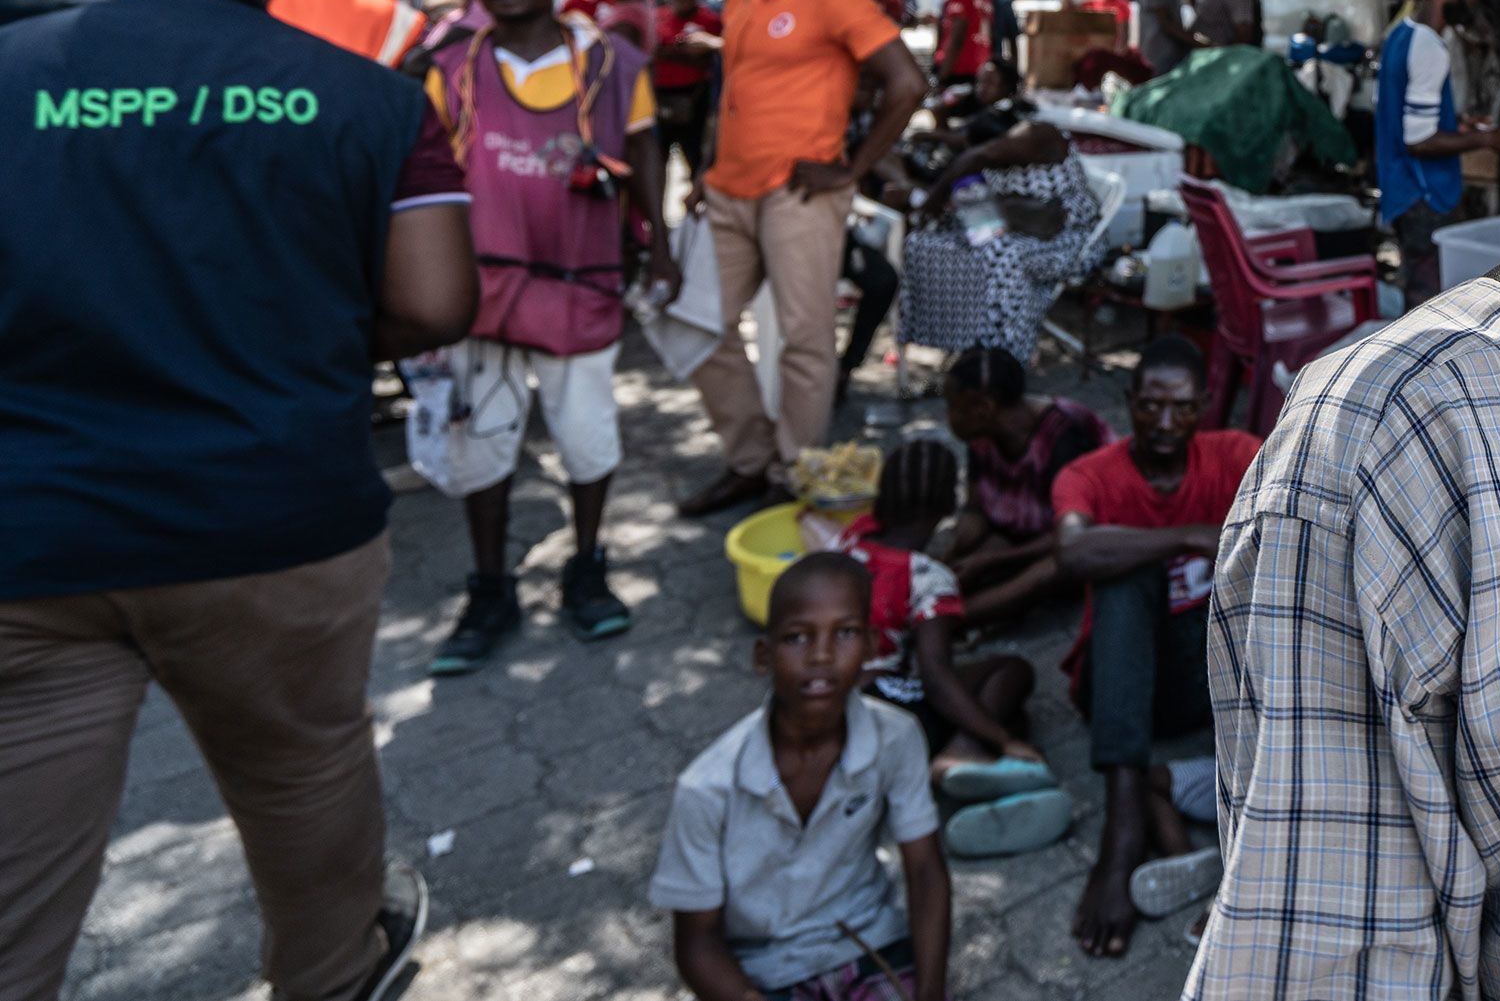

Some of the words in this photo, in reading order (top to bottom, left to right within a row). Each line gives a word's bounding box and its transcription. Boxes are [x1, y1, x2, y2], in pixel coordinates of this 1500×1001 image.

[36, 88, 176, 130] MSPP
[190, 86, 209, 123] /
[223, 86, 318, 123] DSO
